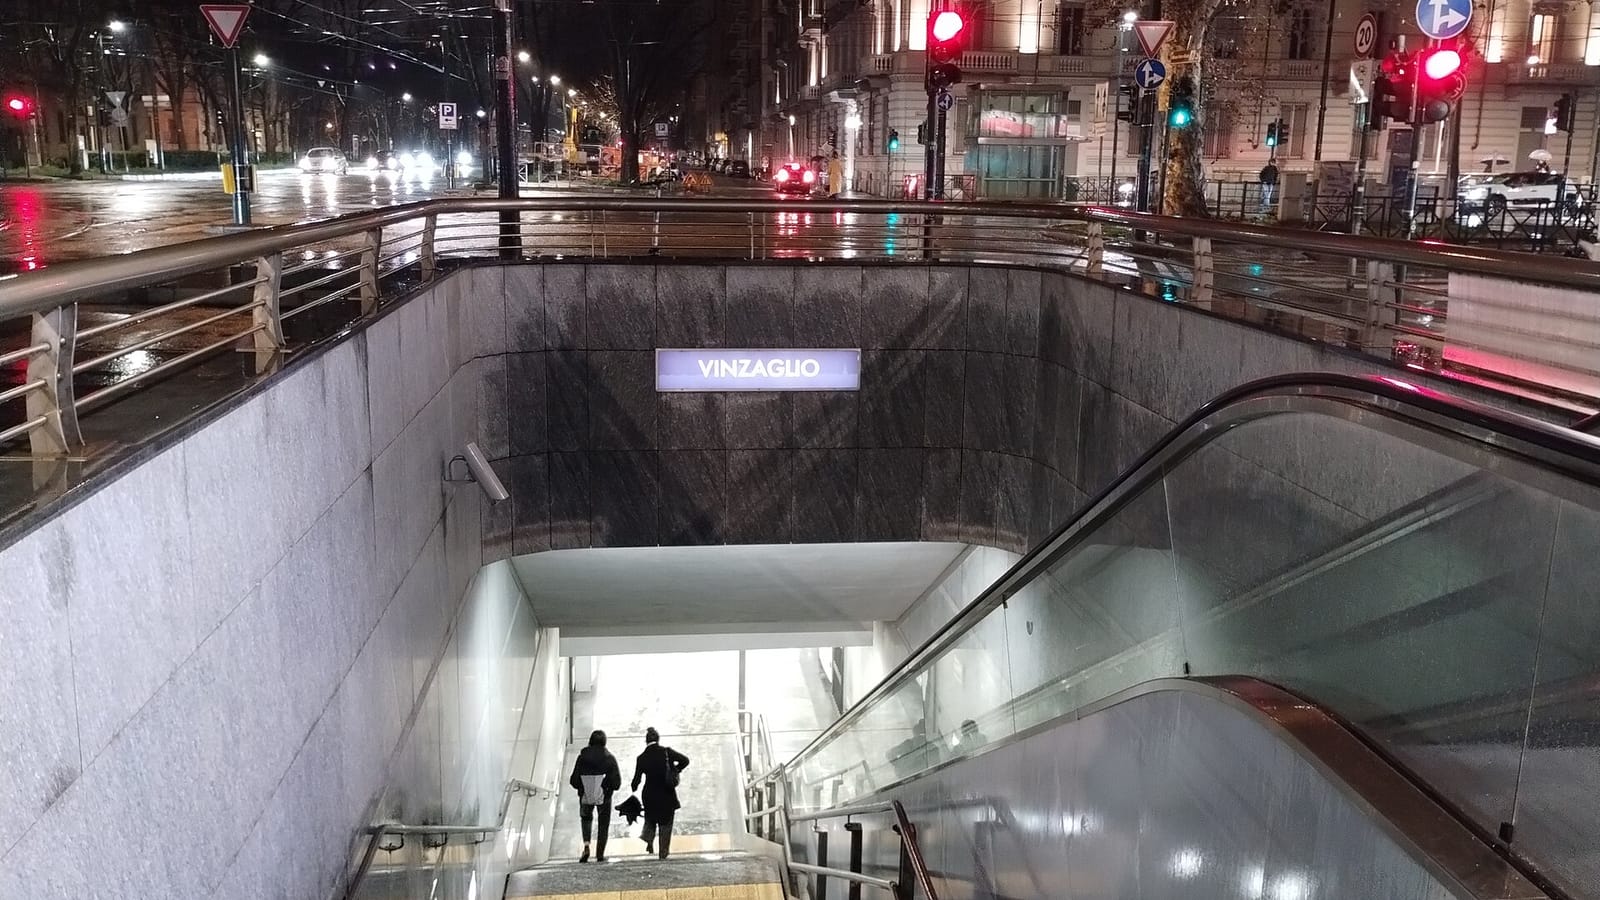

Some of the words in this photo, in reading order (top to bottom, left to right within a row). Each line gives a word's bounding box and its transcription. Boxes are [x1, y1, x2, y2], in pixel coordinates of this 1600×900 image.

[1359, 26, 1371, 47] 20
[443, 105, 452, 116] P
[698, 358, 821, 378] VINZAGLIO
